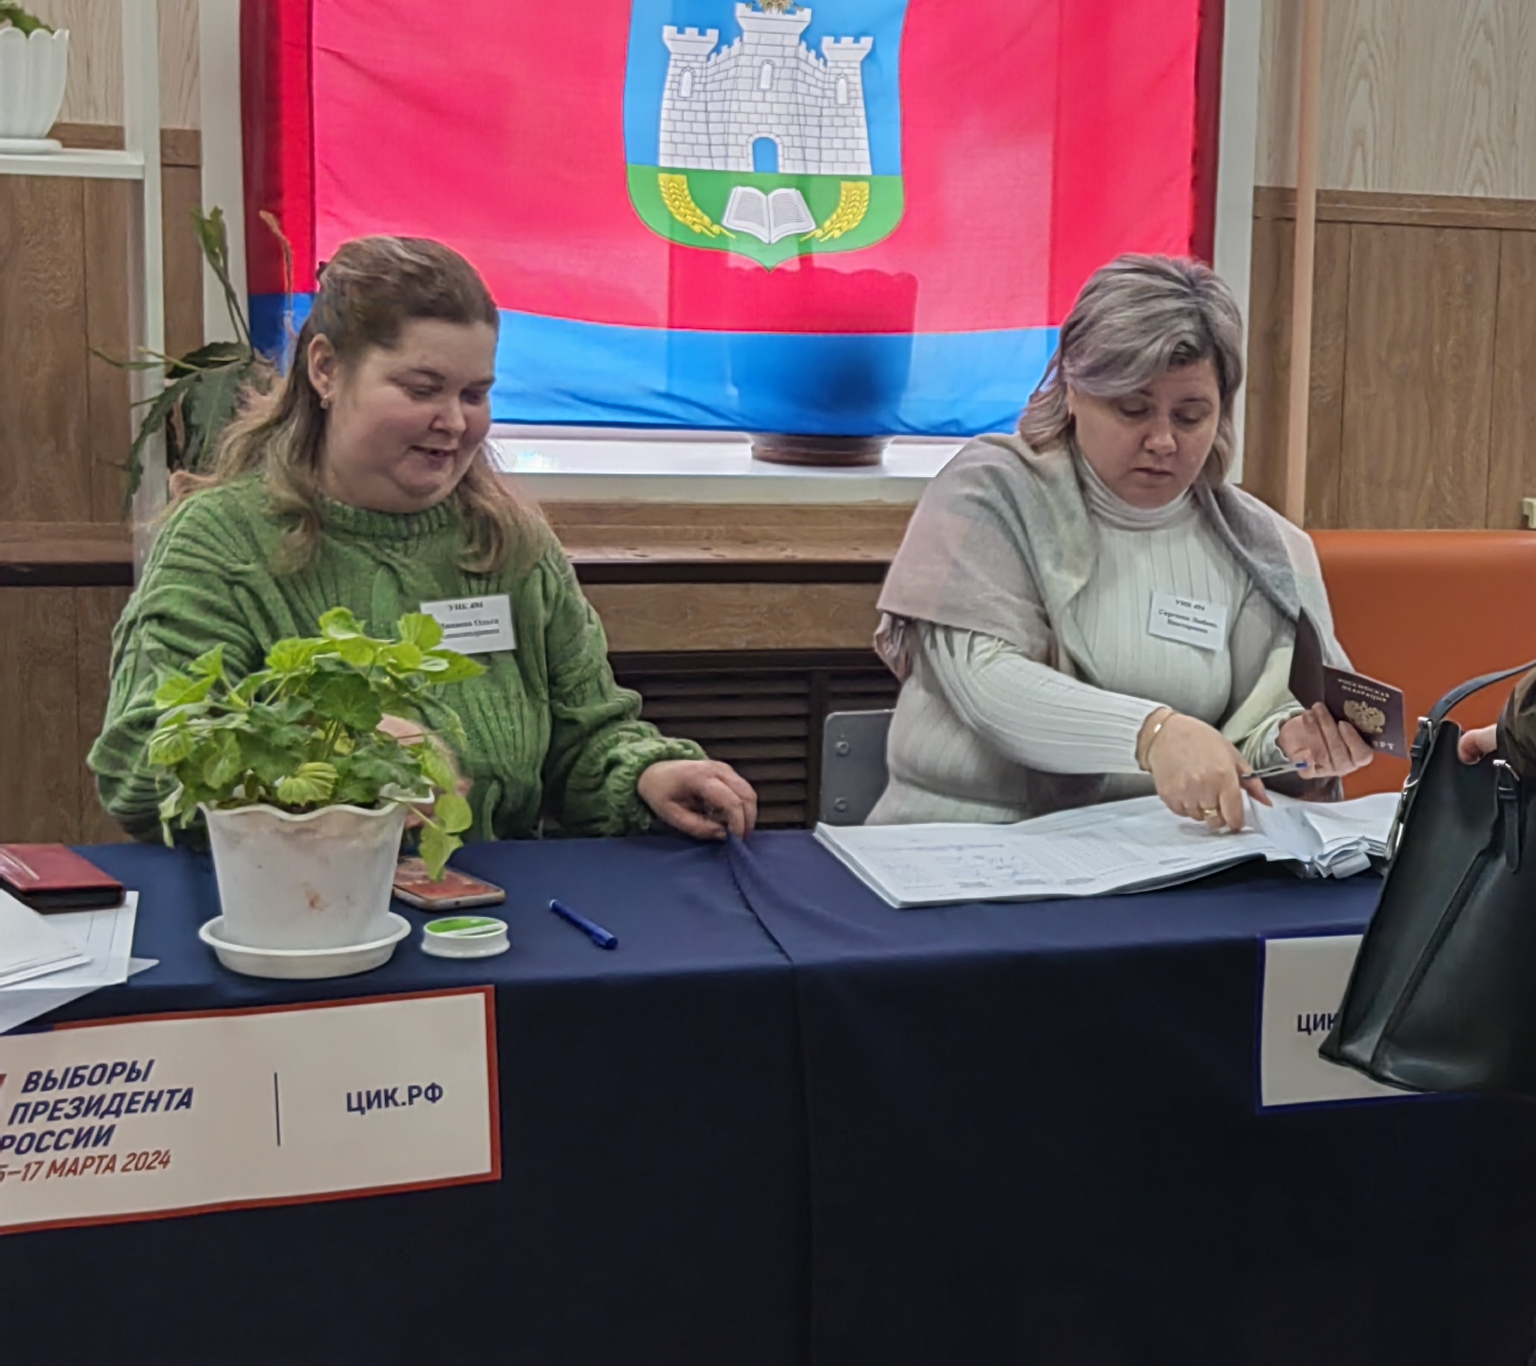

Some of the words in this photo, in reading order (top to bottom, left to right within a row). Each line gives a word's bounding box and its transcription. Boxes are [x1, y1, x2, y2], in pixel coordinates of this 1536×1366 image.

[21, 1059, 155, 1094] ВЫБОРЫ
[8, 1087, 194, 1126] ПРЕЗИДЕНТА
[346, 1082, 444, 1115] ЦИК.РФ
[0, 1124, 116, 1155] РОССИИ
[45, 1154, 117, 1179] МАРТА
[121, 1149, 171, 1173] 2024
